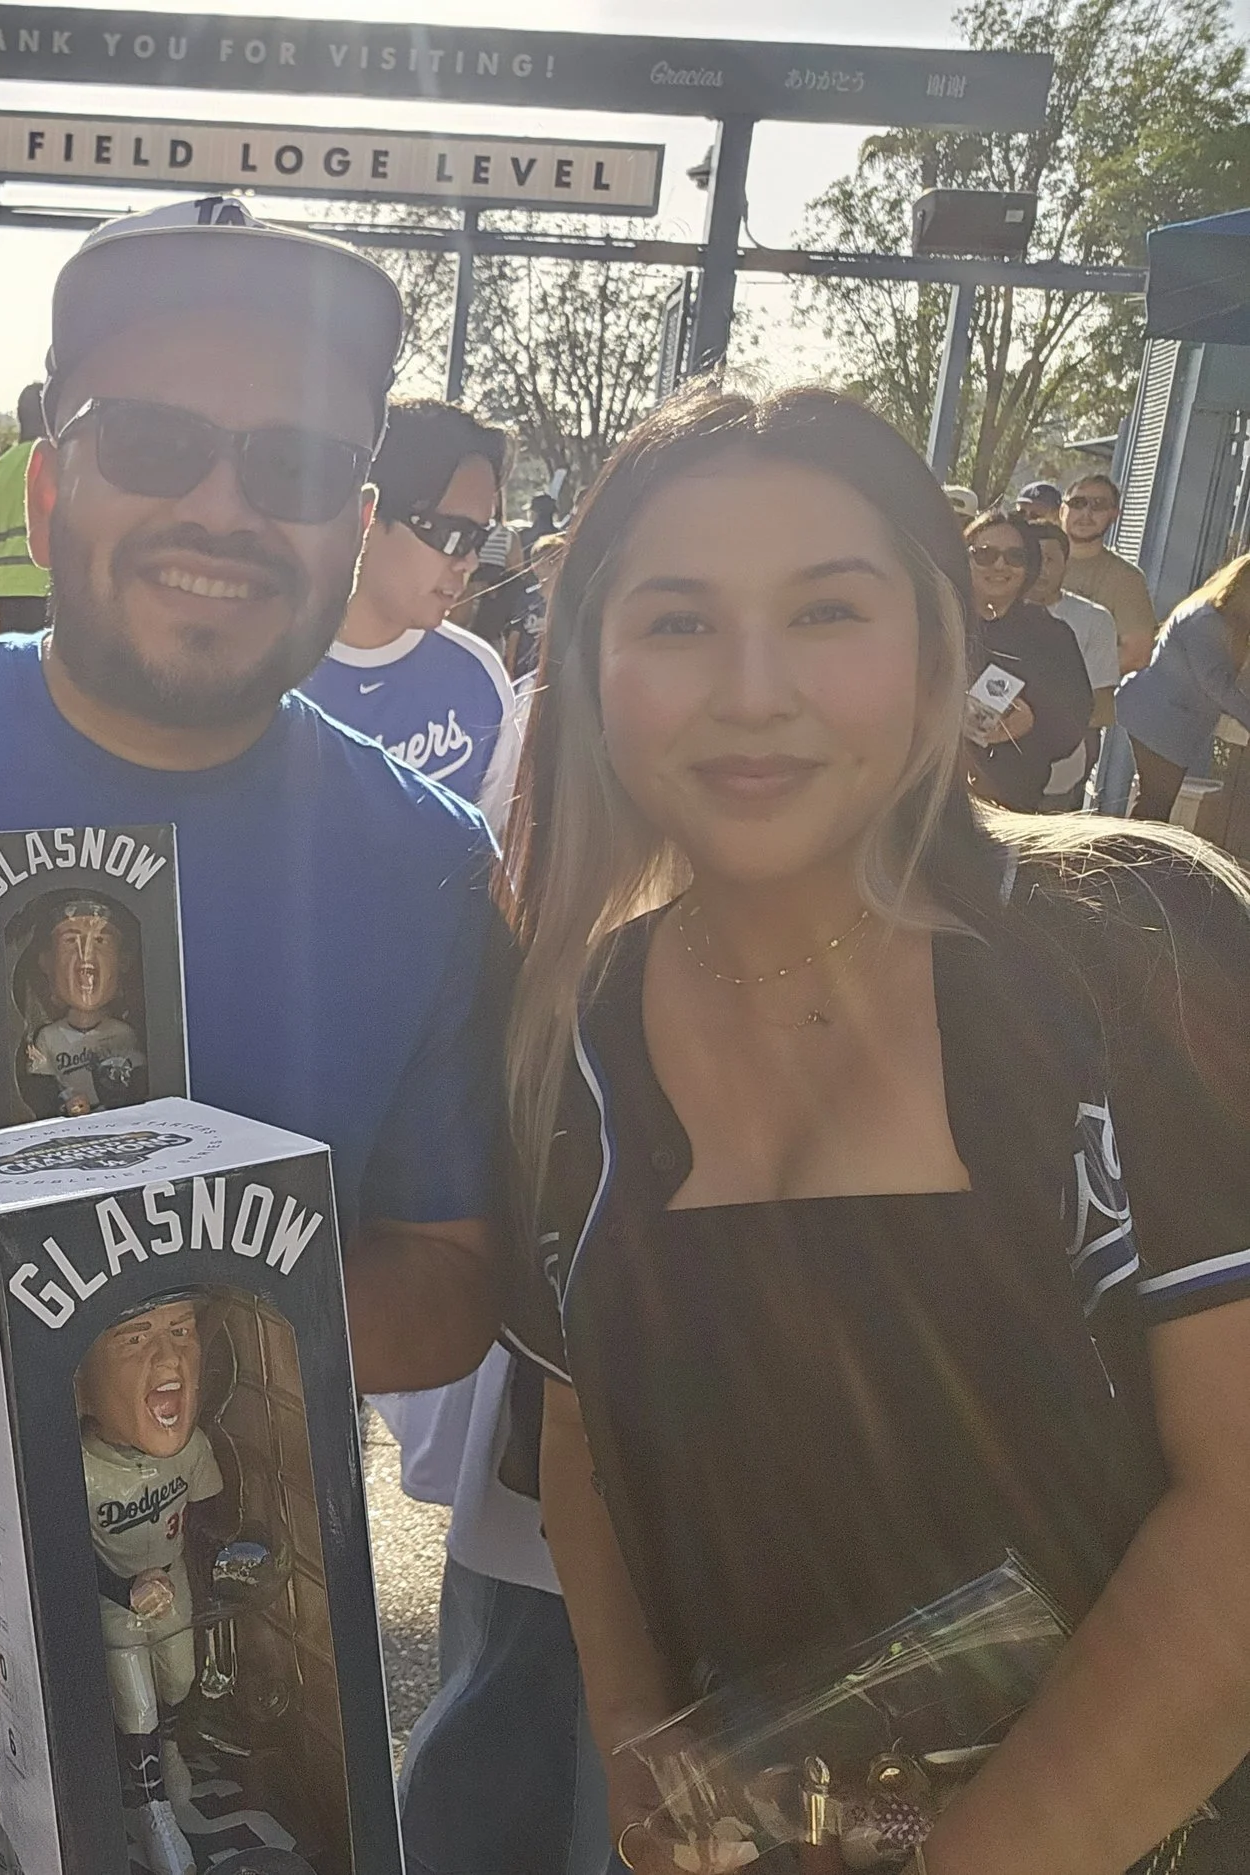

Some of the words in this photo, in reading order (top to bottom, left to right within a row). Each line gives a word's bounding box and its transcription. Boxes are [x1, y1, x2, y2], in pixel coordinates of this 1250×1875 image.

[103, 33, 187, 60] YOU
[219, 39, 296, 66] FOR
[329, 44, 555, 78] VISITING!
[650, 60, 724, 87] Gracias
[784, 68, 865, 93] ありがとう
[27, 131, 193, 168] FIELD
[240, 142, 390, 179] LOGE
[435, 152, 611, 191] LEVEL
[9, 1176, 324, 1330] GLASNOW
[97, 1476, 188, 1534] Dodgers
[0, 1653, 7, 1681] 0
[8, 1727, 16, 1757] 6
